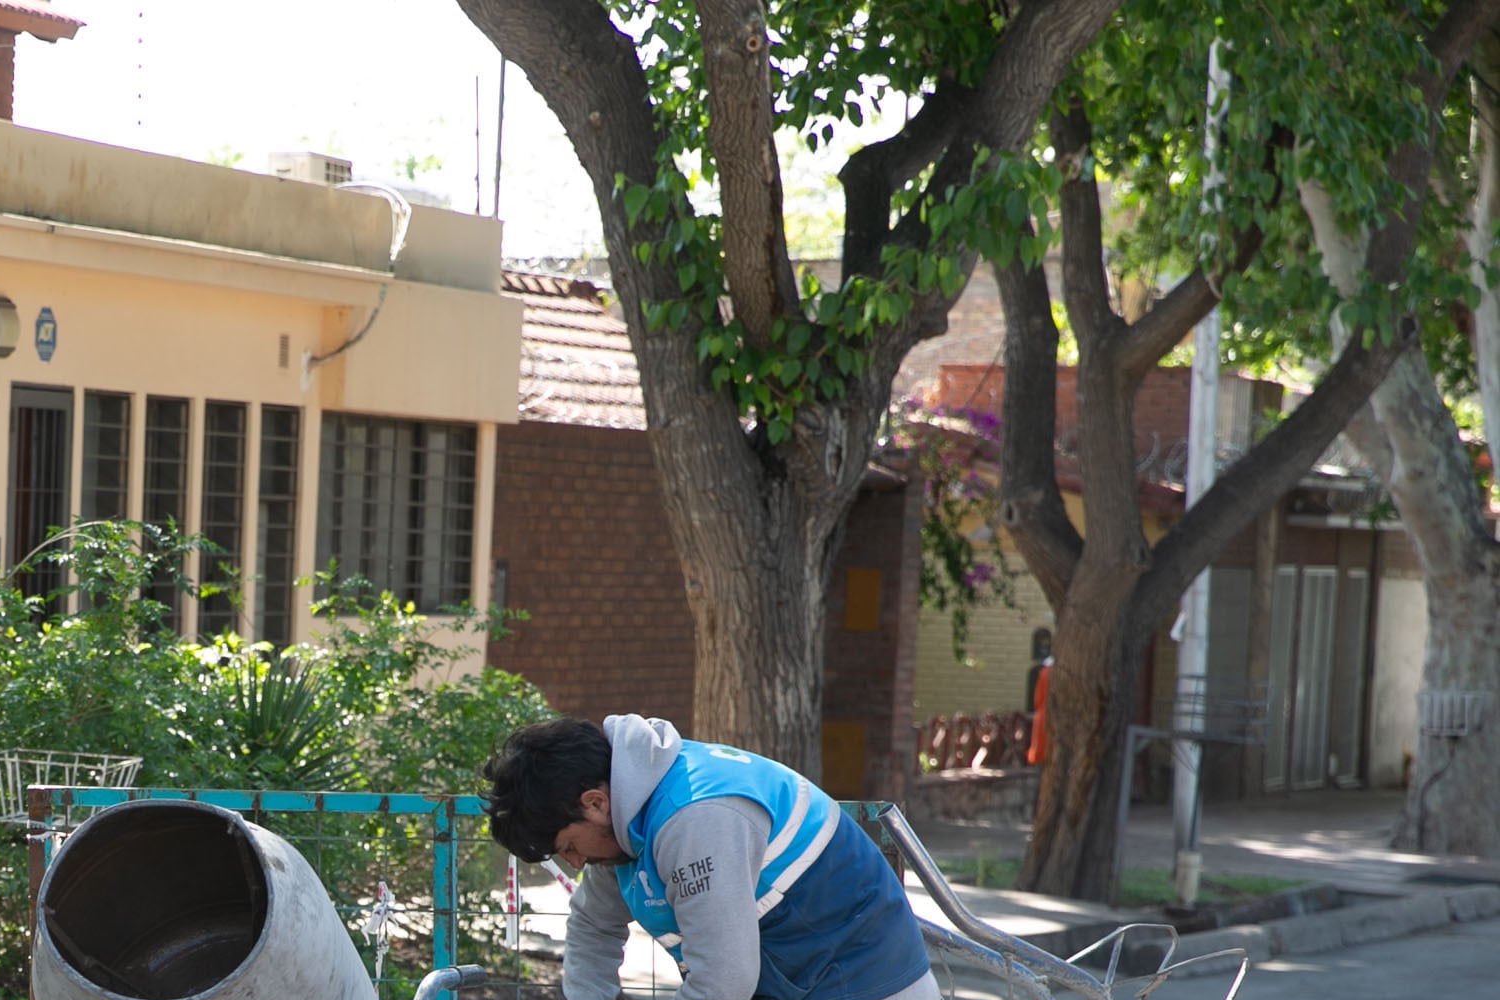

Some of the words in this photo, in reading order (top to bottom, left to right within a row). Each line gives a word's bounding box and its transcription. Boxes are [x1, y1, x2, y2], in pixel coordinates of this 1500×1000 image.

[671, 867, 688, 884] BE
[688, 856, 714, 878] THE
[679, 876, 711, 898] LIGHT
